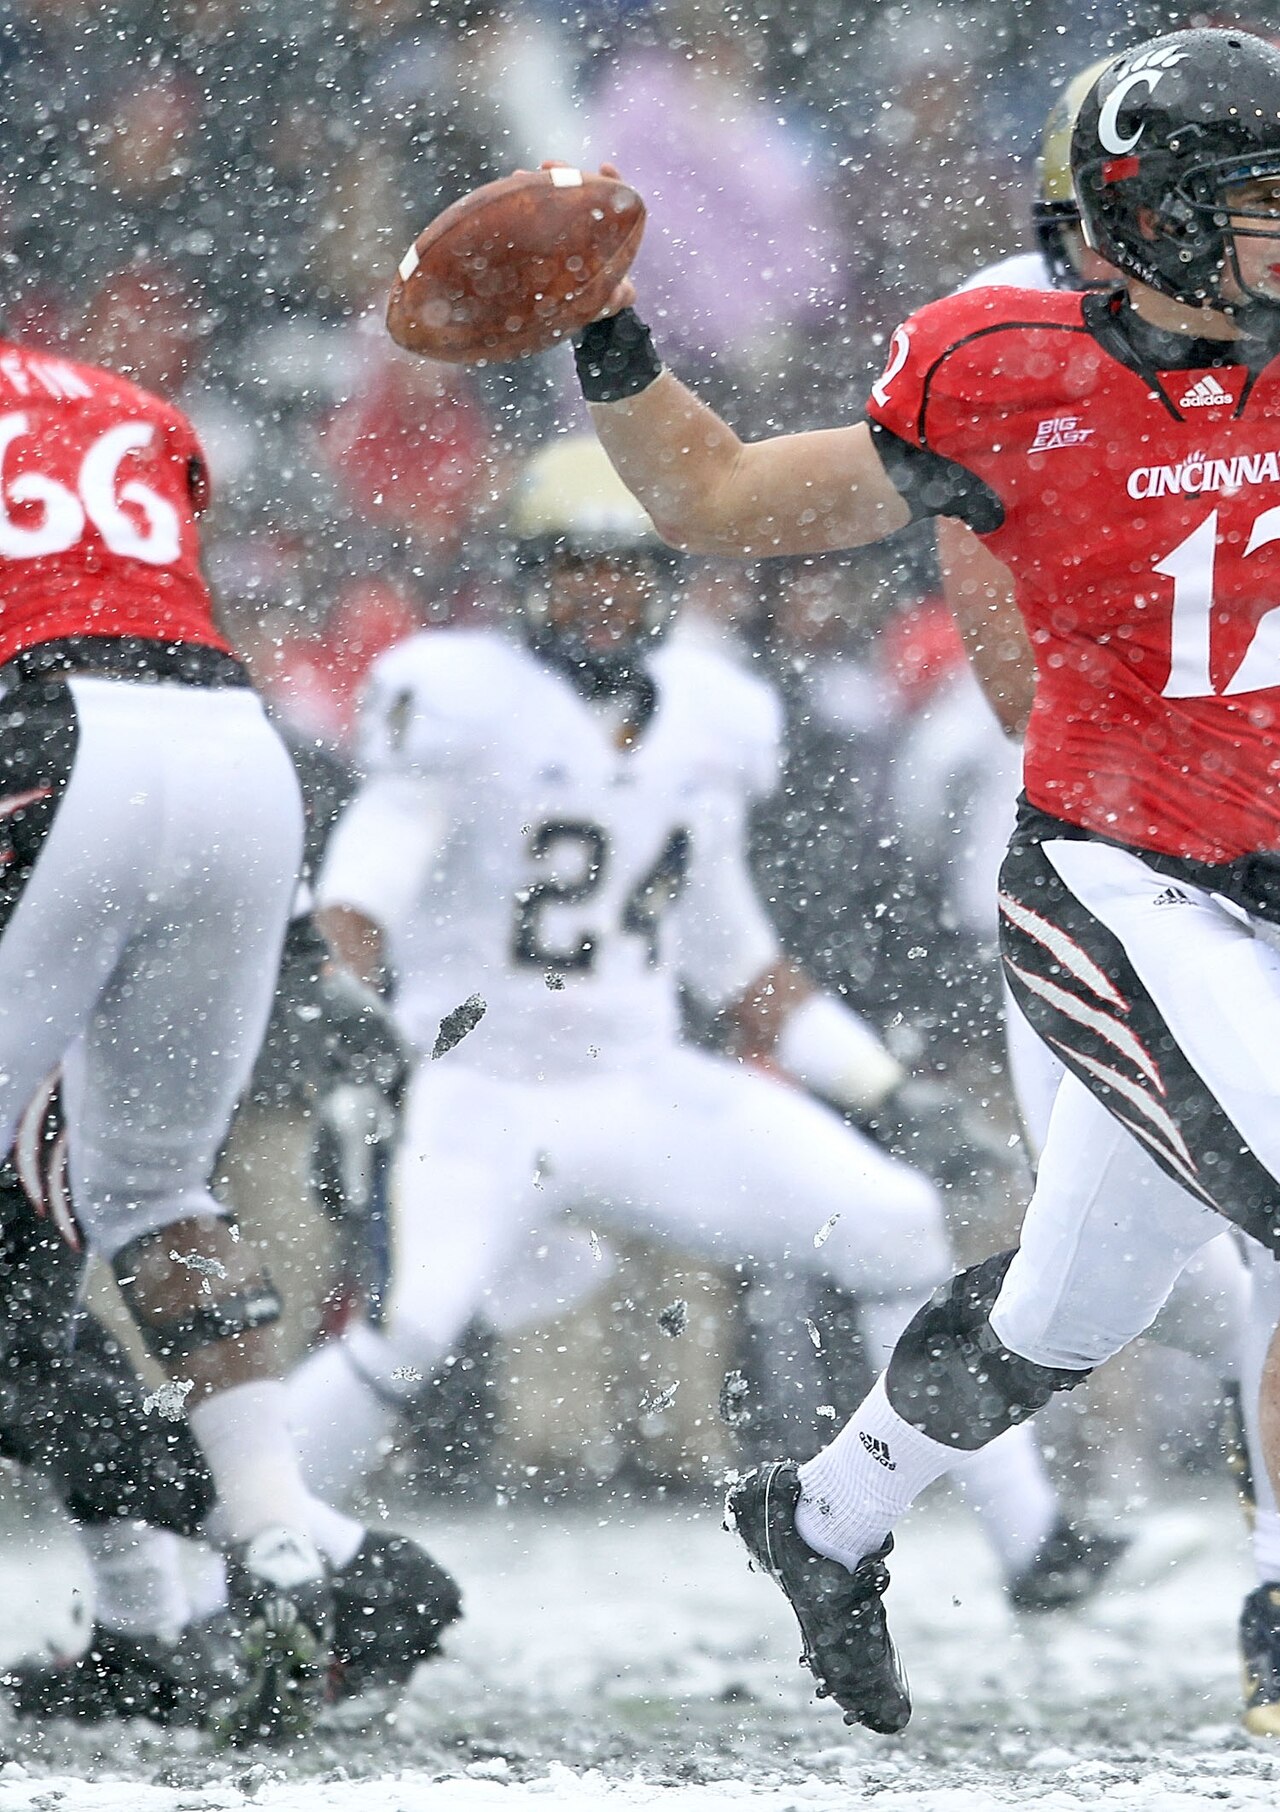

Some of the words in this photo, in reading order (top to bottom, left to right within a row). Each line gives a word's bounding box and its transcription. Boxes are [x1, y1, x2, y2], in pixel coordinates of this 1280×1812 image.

[872, 323, 911, 408] 2
[1036, 415, 1083, 435] BIG
[1179, 393, 1234, 408] adidas
[1032, 427, 1096, 448] EAST
[0, 410, 182, 562] 66
[512, 818, 694, 975] 24
